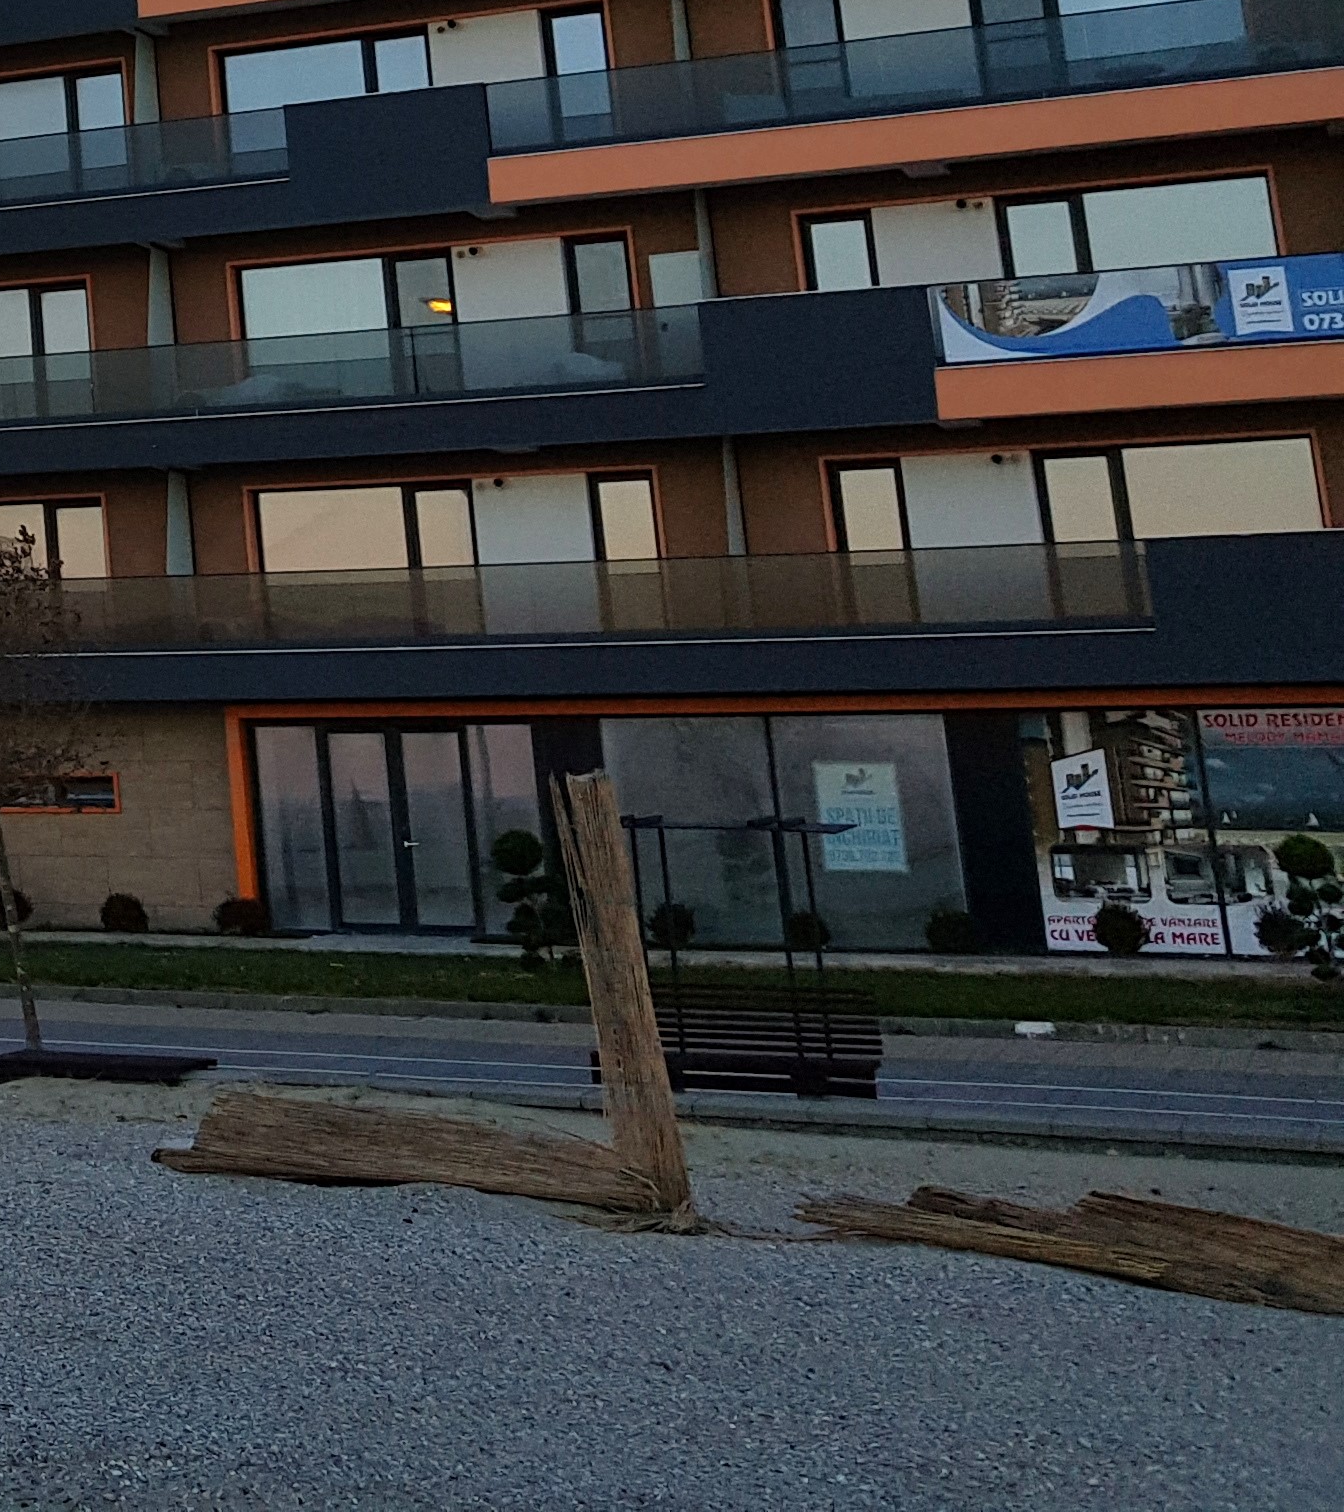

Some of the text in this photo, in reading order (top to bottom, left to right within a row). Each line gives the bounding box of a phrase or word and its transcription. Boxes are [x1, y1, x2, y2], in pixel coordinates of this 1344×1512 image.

[1203, 713, 1258, 728] SOLID
[1050, 928, 1070, 941] CU
[1171, 931, 1221, 946] MARE
